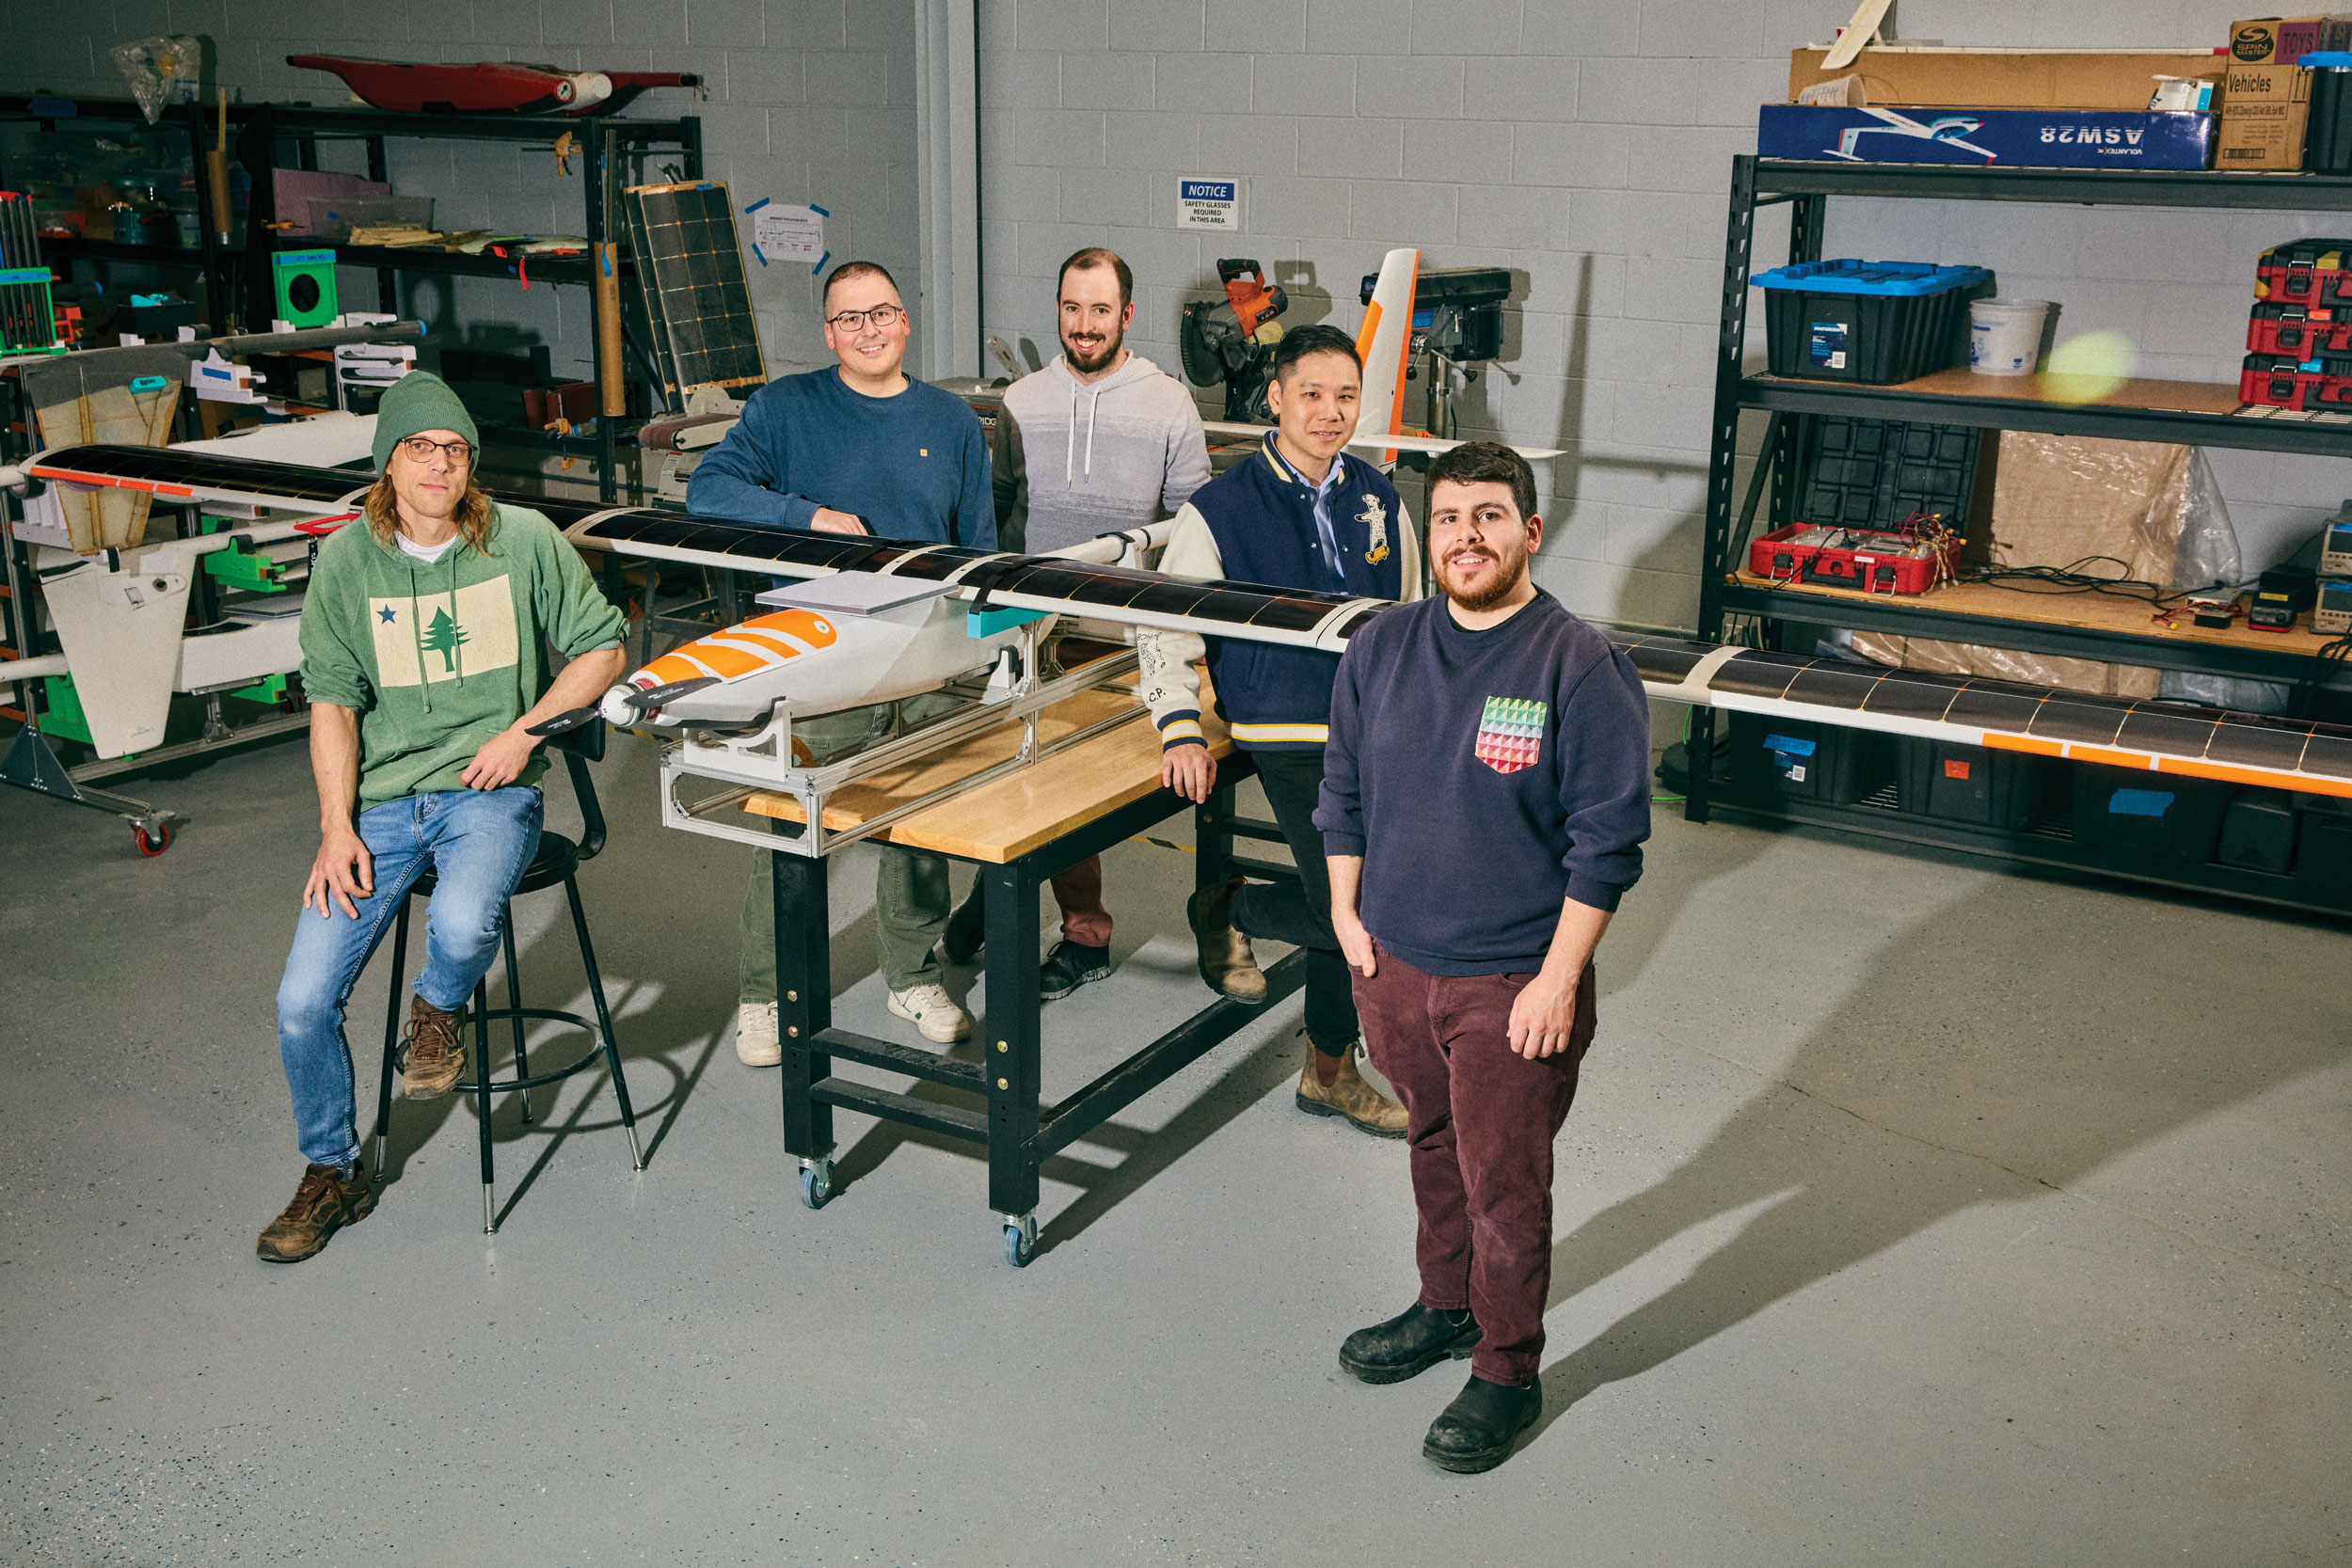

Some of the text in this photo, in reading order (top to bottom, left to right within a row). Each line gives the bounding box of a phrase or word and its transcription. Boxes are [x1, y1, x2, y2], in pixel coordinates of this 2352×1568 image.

[2283, 32, 2313, 54] TOYS
[2229, 74, 2271, 92] Vehicles
[2040, 126, 2144, 145] ASW28
[1188, 184, 1227, 198] NOTICE
